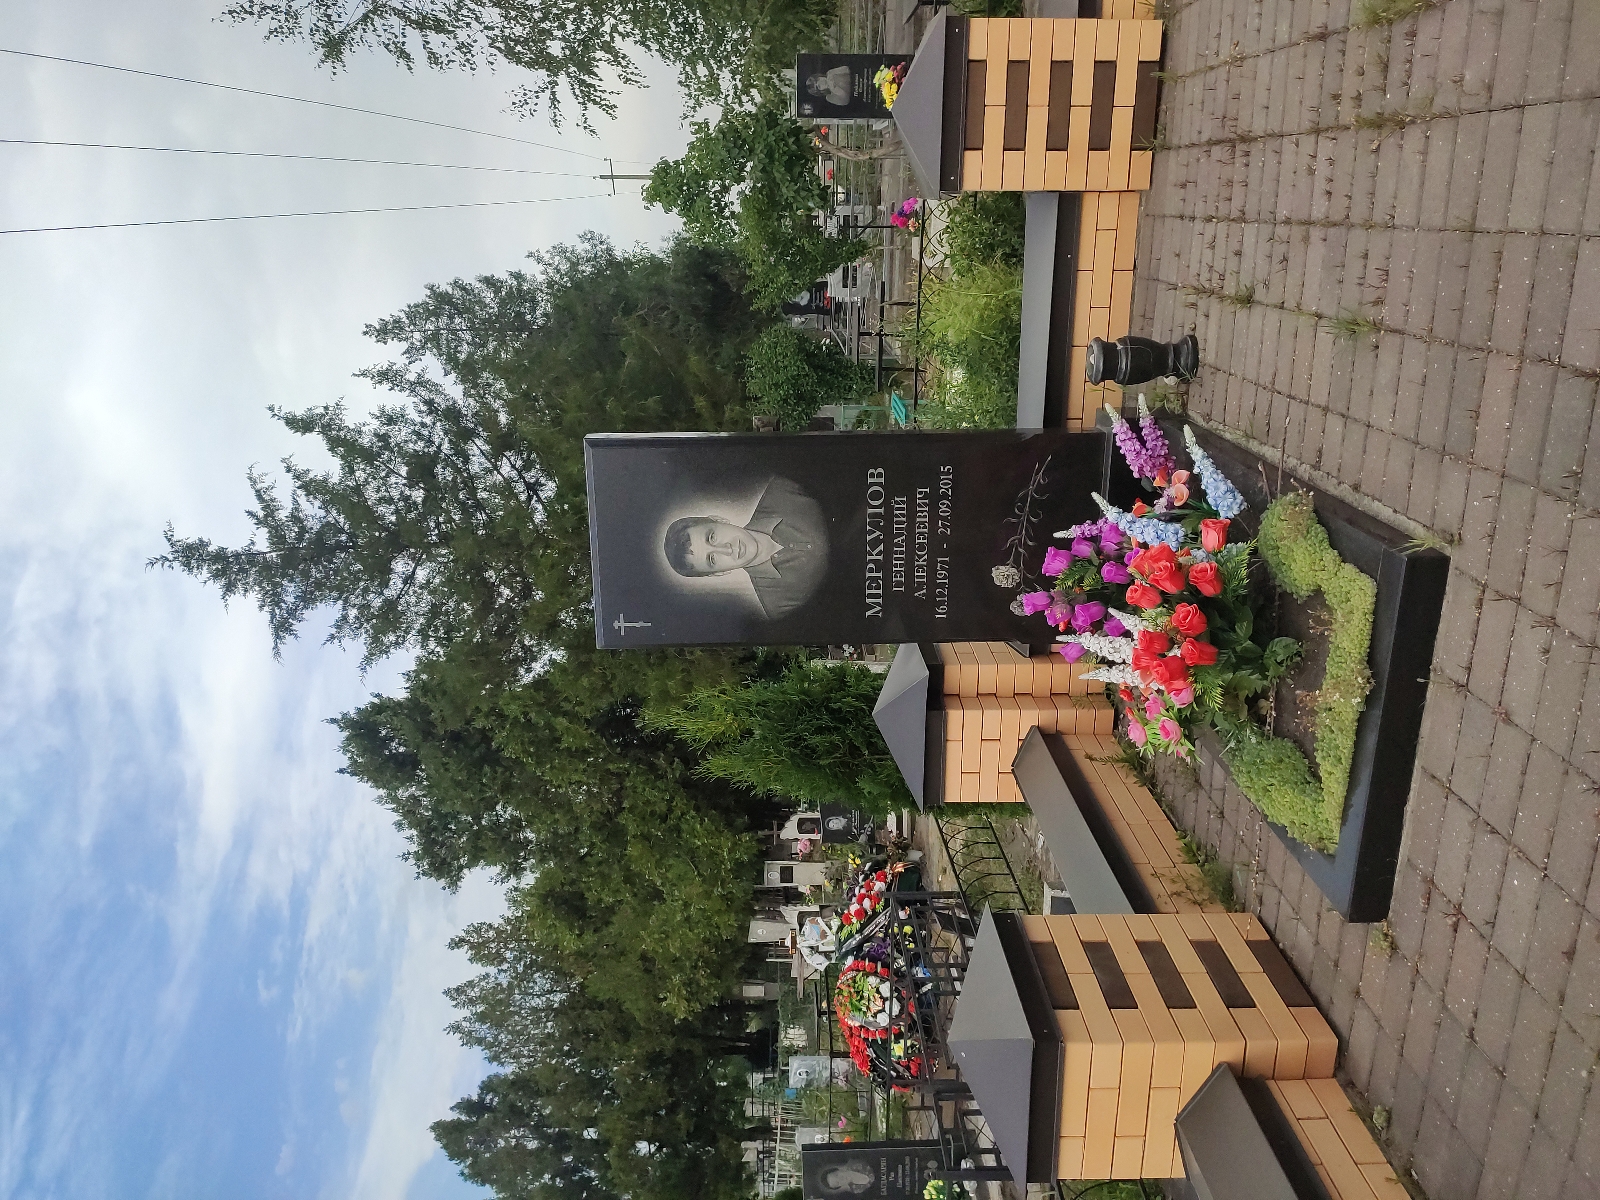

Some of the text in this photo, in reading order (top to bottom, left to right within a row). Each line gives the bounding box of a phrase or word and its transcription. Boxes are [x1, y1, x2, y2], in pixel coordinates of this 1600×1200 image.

[865, 467, 885, 618] МЕРКУЛОВ
[890, 495, 907, 592] ГЕННАДИЙ
[914, 487, 930, 599] АЛЕКСЕЕВИЧ
[937, 465, 953, 535] 27.09.2015
[935, 556, 950, 619] 16.12.1971
